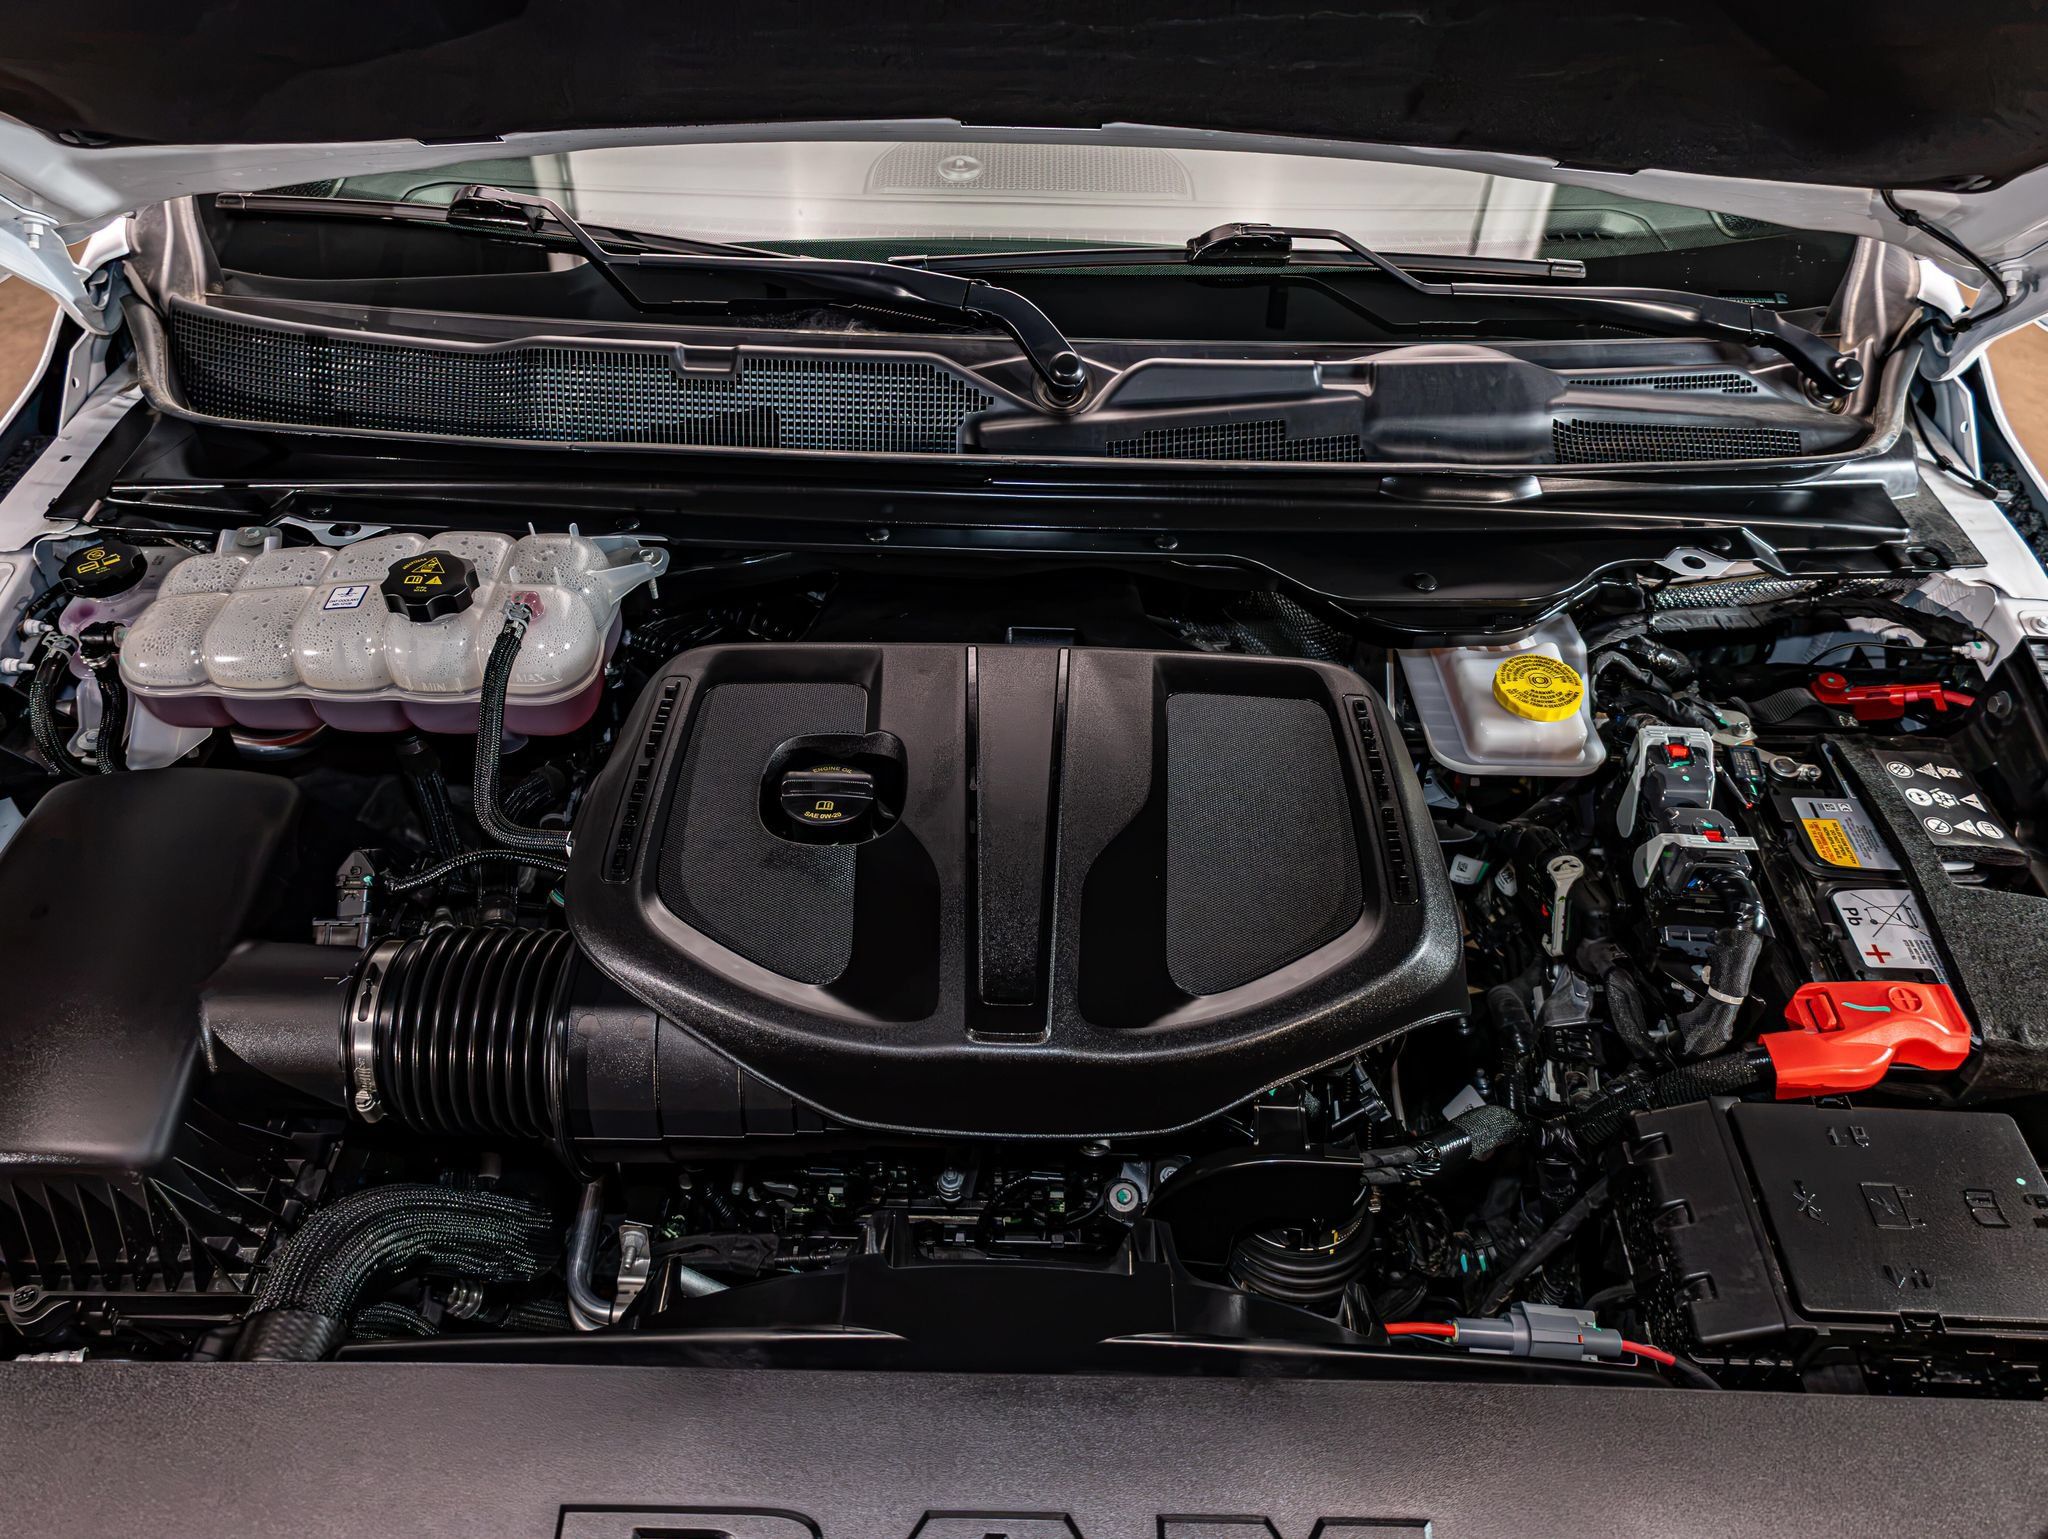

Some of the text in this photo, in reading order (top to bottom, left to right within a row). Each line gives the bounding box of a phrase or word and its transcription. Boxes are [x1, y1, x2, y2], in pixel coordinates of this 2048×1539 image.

[515, 673, 546, 682] MAX
[421, 683, 446, 691] MIN
[1844, 846, 1857, 864] BATTERY
[1842, 907, 1862, 926] Pb
